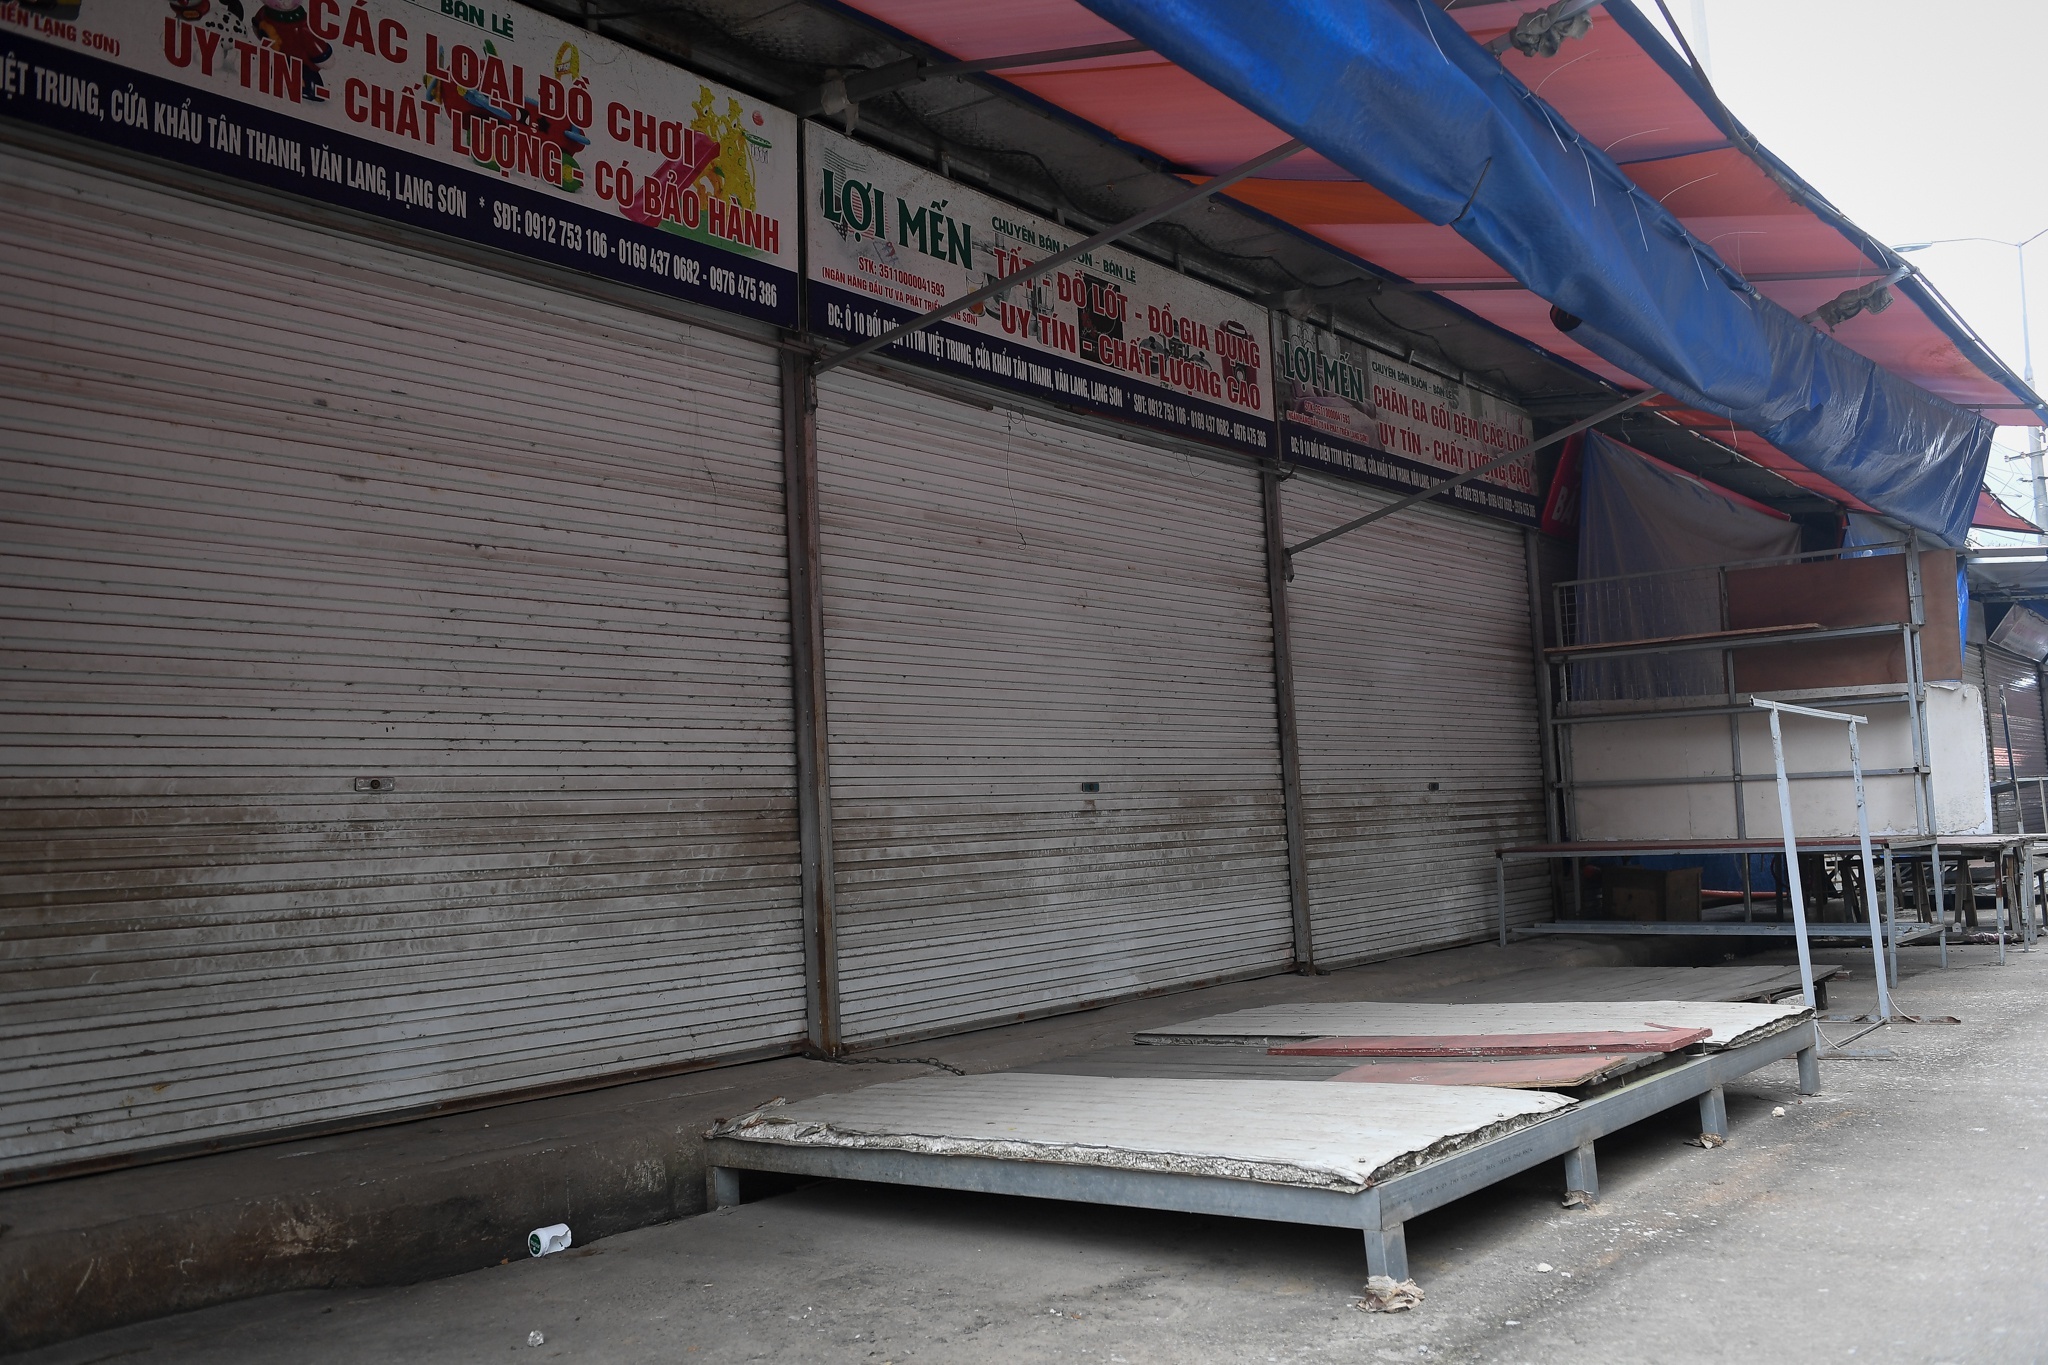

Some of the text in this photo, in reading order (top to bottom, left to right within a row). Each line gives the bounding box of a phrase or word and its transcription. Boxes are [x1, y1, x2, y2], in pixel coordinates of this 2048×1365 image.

[34, 14, 77, 42] LẠNG
[82, 30, 120, 57] SƠN)
[308, 0, 695, 168] CÁC LOẠI ĐỒ CHƠI
[164, 16, 221, 77] UY
[234, 38, 302, 104] TÍN
[344, 78, 441, 146] CHẤT
[452, 110, 562, 187] LƯỢNG
[595, 160, 634, 208] CÓ
[643, 169, 700, 229] BẢO
[708, 197, 779, 255] HÀNH
[34, 65, 104, 121] TRUNG,
[111, 83, 148, 130] CỬA
[154, 98, 202, 144] KHẨU
[208, 114, 242, 156] TÂN
[246, 128, 305, 178] THANH,
[310, 144, 343, 184] VĂN
[347, 157, 390, 200] LANG,
[395, 171, 433, 209] LẠNG
[438, 183, 467, 218] SƠN
[493, 200, 521, 234] SĐT:
[524, 210, 556, 244] 0912
[559, 220, 582, 251] 753
[586, 229, 608, 258] 106
[618, 238, 646, 270] 0169
[650, 247, 670, 277] 437
[673, 250, 700, 285] 0682
[710, 266, 735, 296] 0976
[738, 274, 756, 302] 475
[759, 283, 777, 308] 386
[822, 168, 973, 271] LỢI MẾN
[858, 257, 877, 275] STK:
[992, 216, 1036, 245] CHUYÊN
[1039, 234, 1061, 252] BÁN
[1103, 259, 1123, 278] BÁN
[854, 311, 865, 335] 10
[946, 337, 973, 370] TRUNG,
[1147, 397, 1163, 419] 0912
[1163, 402, 1174, 422] 753
[1001, 301, 1031, 339] UY
[1038, 313, 1076, 354] TÍN
[1100, 335, 1153, 377] CHẤT
[1159, 353, 1221, 398] LƯỢNG
[1227, 376, 1261, 410] CAO
[1057, 269, 1086, 308] ĐỒ
[1092, 284, 1128, 323] LÓT
[1148, 302, 1174, 337] ĐỒ
[1180, 316, 1210, 351] GIA
[1215, 328, 1261, 369] DỤNG
[1284, 340, 1364, 402] LỢI MẾN
[1373, 384, 1409, 417] CHĂN
[1412, 398, 1429, 424] GA
[1453, 412, 1480, 442] ĐỆM
[1379, 422, 1396, 448] UY
[1400, 427, 1421, 456] TÍN
[1433, 439, 1464, 469] CHẤT
[1508, 464, 1531, 488] CAO
